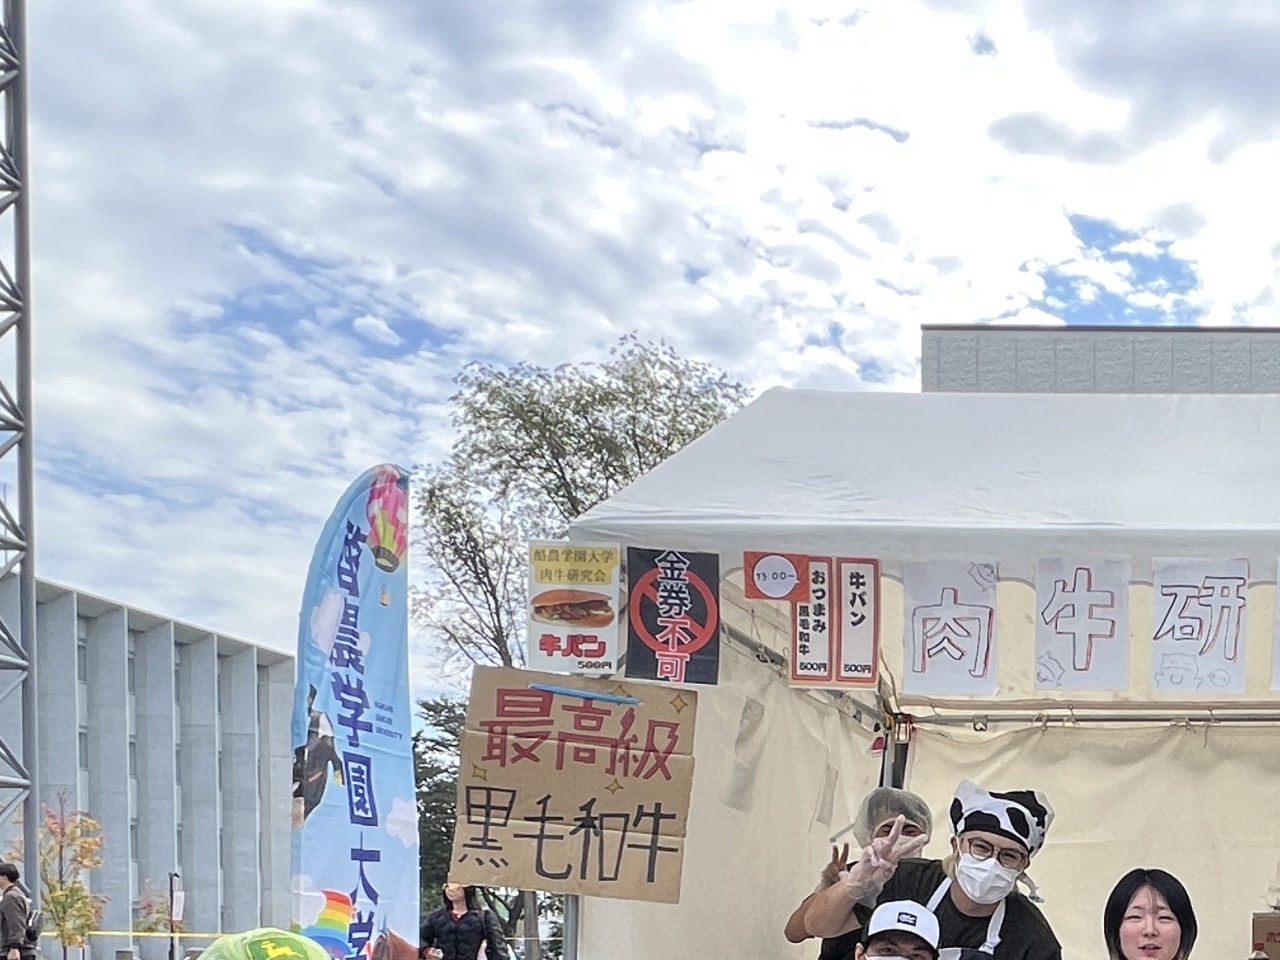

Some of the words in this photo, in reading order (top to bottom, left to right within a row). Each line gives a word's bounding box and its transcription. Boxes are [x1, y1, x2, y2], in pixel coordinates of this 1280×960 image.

[533, 549, 614, 563] 酪農学園大学
[540, 568, 606, 582] 肉牛研究会
[655, 549, 691, 684] 金券不可
[811, 570, 827, 634] おつまみ
[848, 571, 867, 627] 牛パン
[539, 634, 606, 658] 牛パン
[798, 605, 810, 656] 黒毛和牛
[577, 660, 612, 669] 500円
[799, 661, 828, 673] 500円
[843, 664, 872, 674] 500円
[479, 688, 681, 781] 最高級
[458, 786, 679, 883] 黒毛和牛
